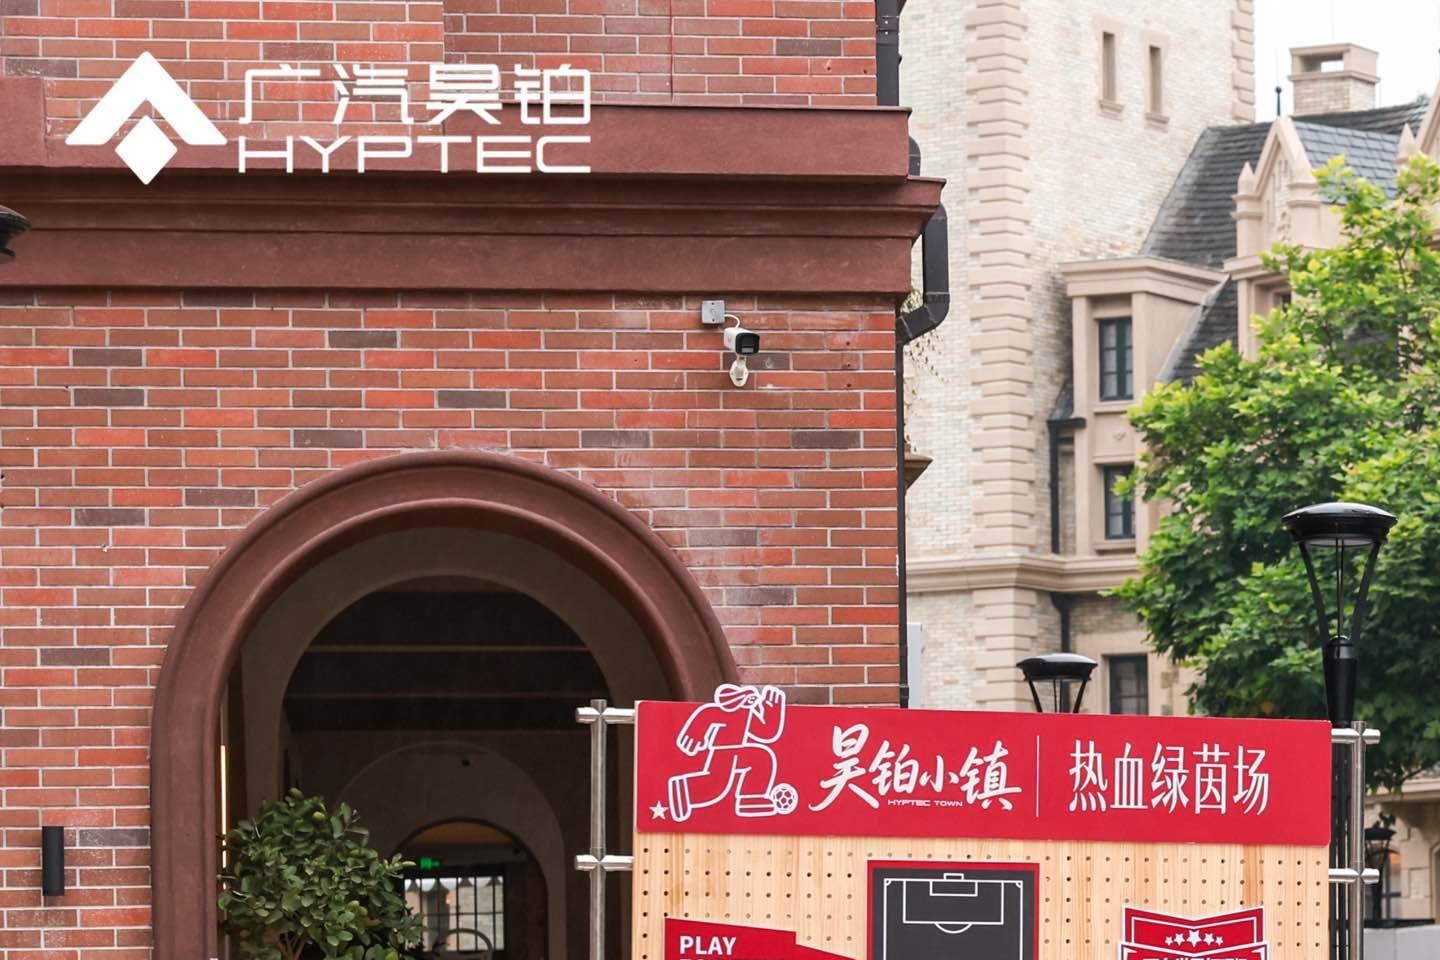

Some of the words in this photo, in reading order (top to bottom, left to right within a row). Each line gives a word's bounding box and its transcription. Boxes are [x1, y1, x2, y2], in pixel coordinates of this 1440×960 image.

[808, 723, 1022, 811] 昊铂小镇
[1068, 739, 1270, 816] 热血绿茵场
[887, 799, 931, 807] HYPTEC
[679, 935, 736, 955] PLAY
